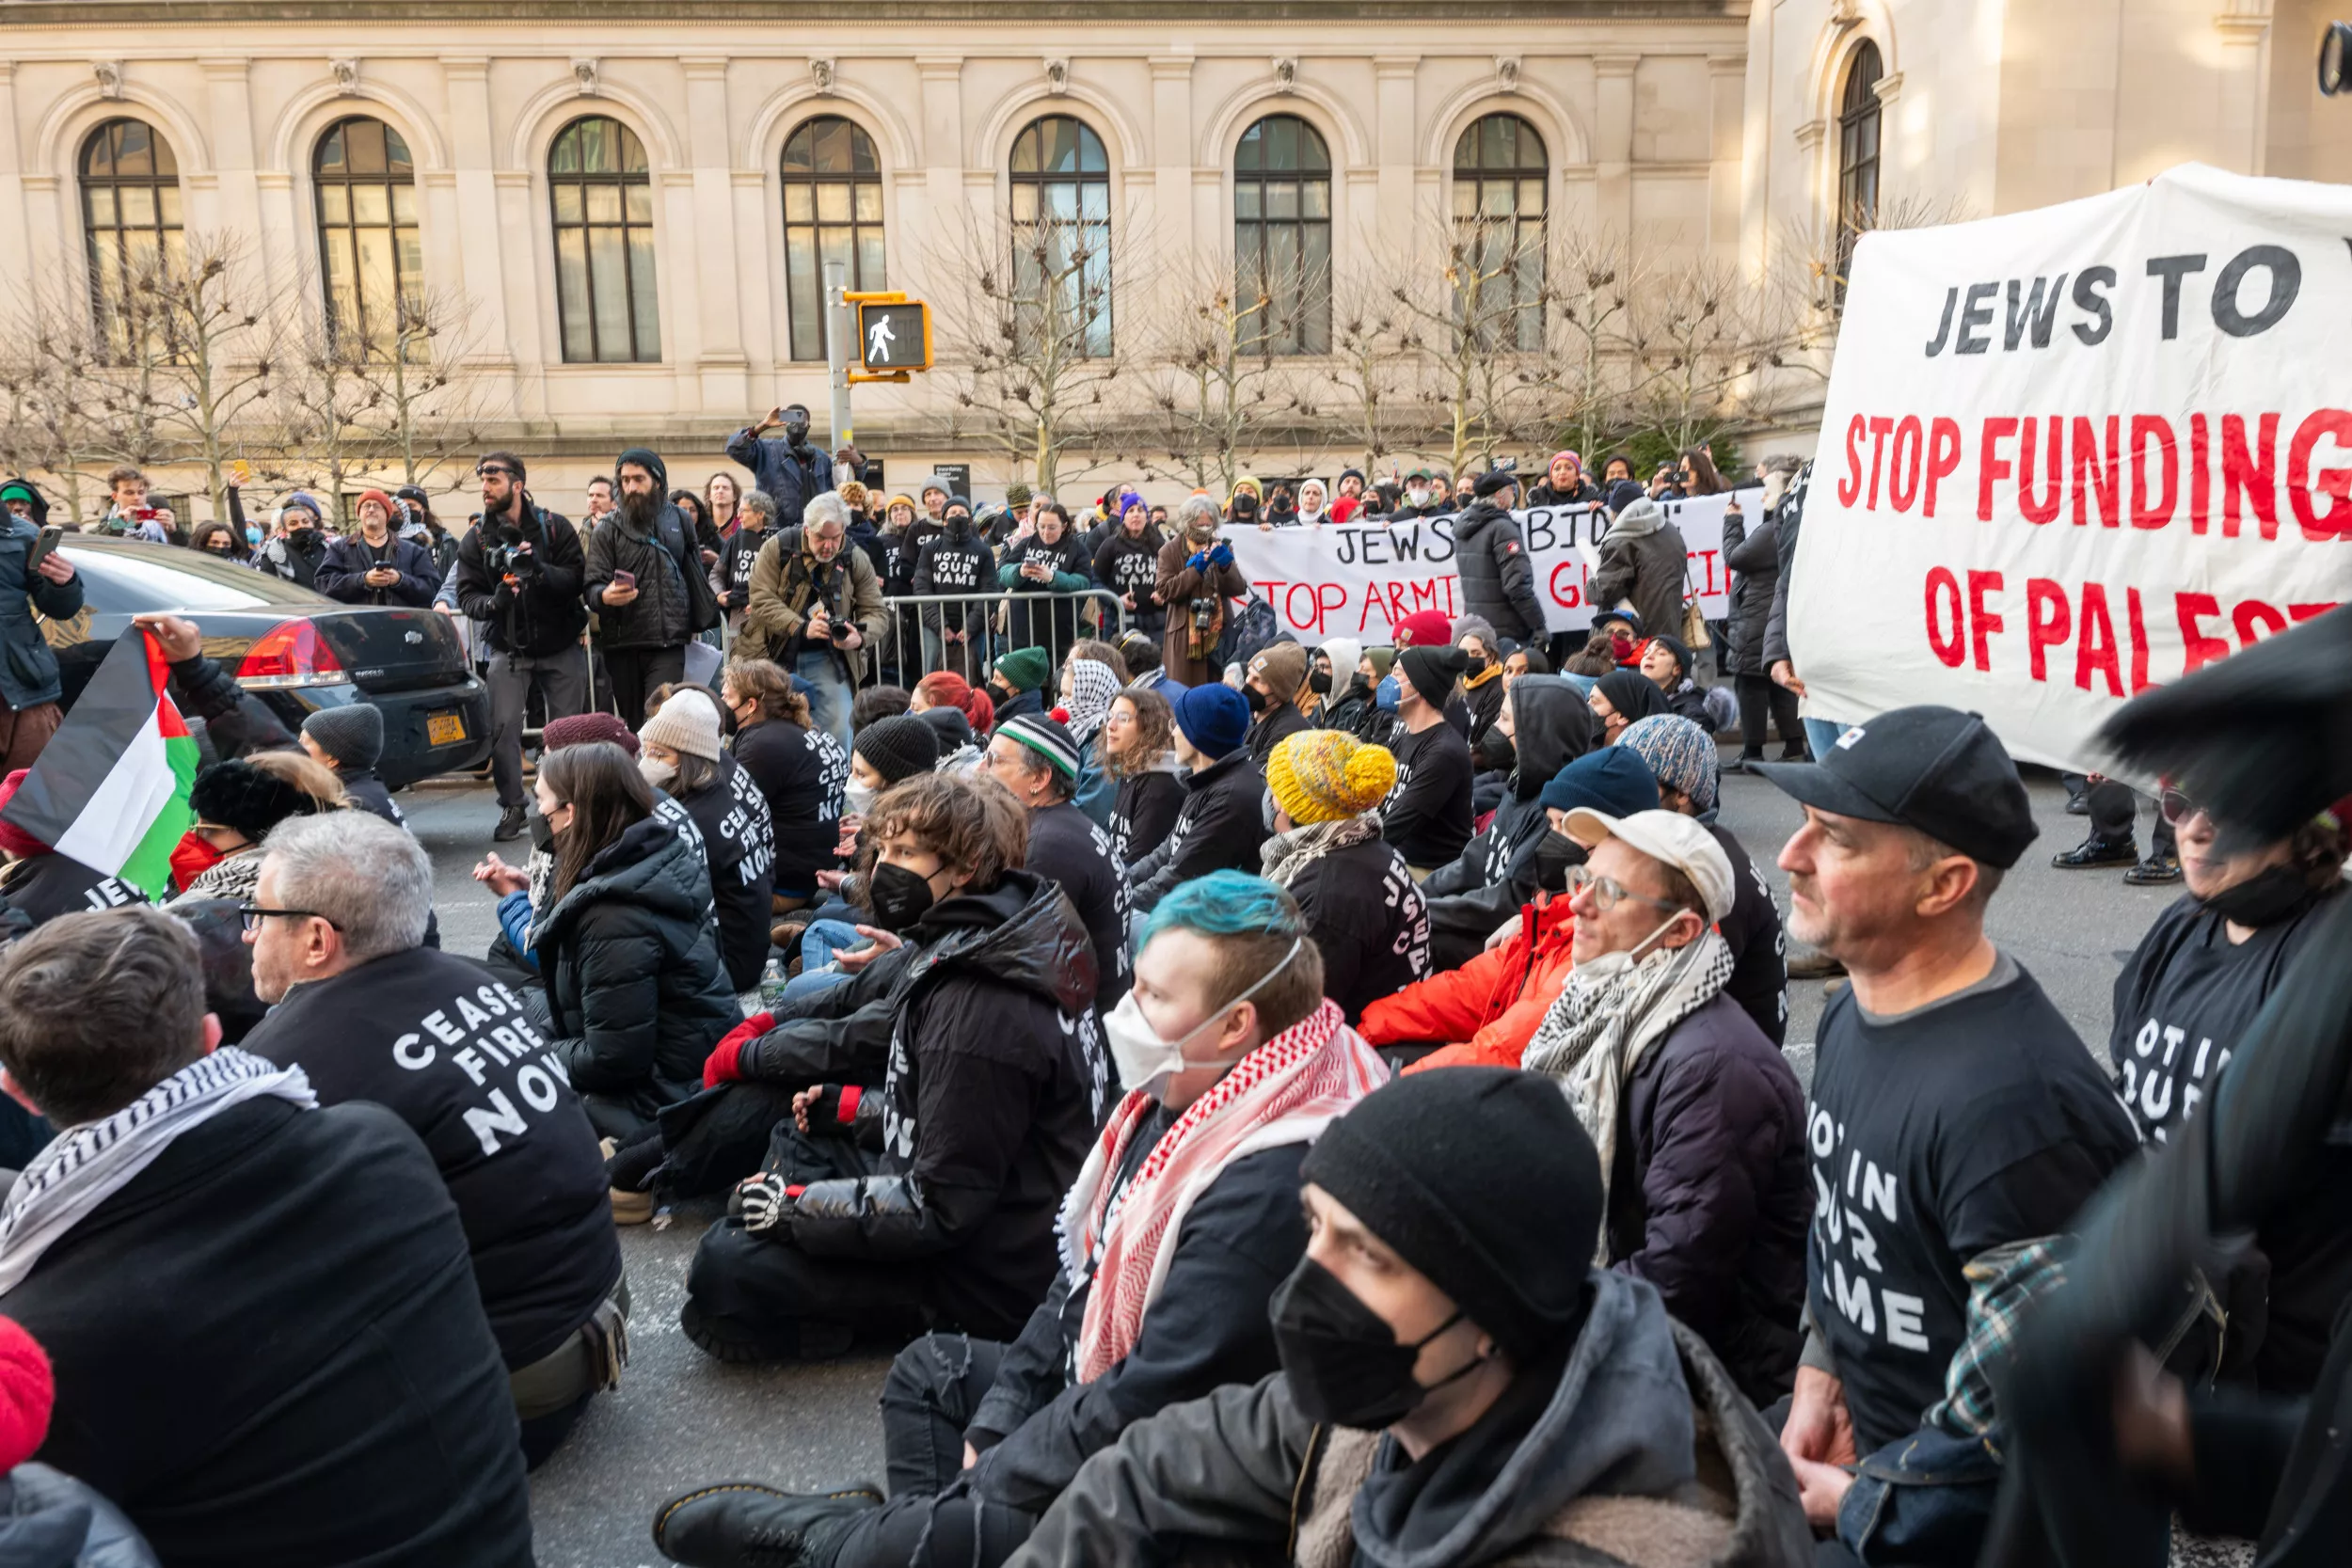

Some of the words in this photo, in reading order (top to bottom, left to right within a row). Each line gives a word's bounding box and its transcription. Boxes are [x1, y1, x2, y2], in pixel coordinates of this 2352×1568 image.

[1925, 265, 2117, 357] JEWS
[2146, 244, 2302, 341] TO
[1837, 413, 1962, 518] STOP
[1977, 407, 2352, 543] FUNDING
[933, 551, 961, 562] NOT
[965, 554, 978, 565] IN
[938, 562, 972, 574] OUR
[1025, 546, 1052, 560] NOT
[1055, 552, 1067, 564] IN
[1336, 518, 1454, 564] JEWS
[933, 572, 977, 586] NAME
[1115, 573, 1154, 585] NAM
[1231, 580, 1348, 635] TOP
[1359, 573, 1460, 633] ARMI
[1925, 565, 2004, 673] OF
[392, 982, 523, 1070] CEASE
[453, 1016, 545, 1086] FIRE
[1847, 1148, 1897, 1223] IN
